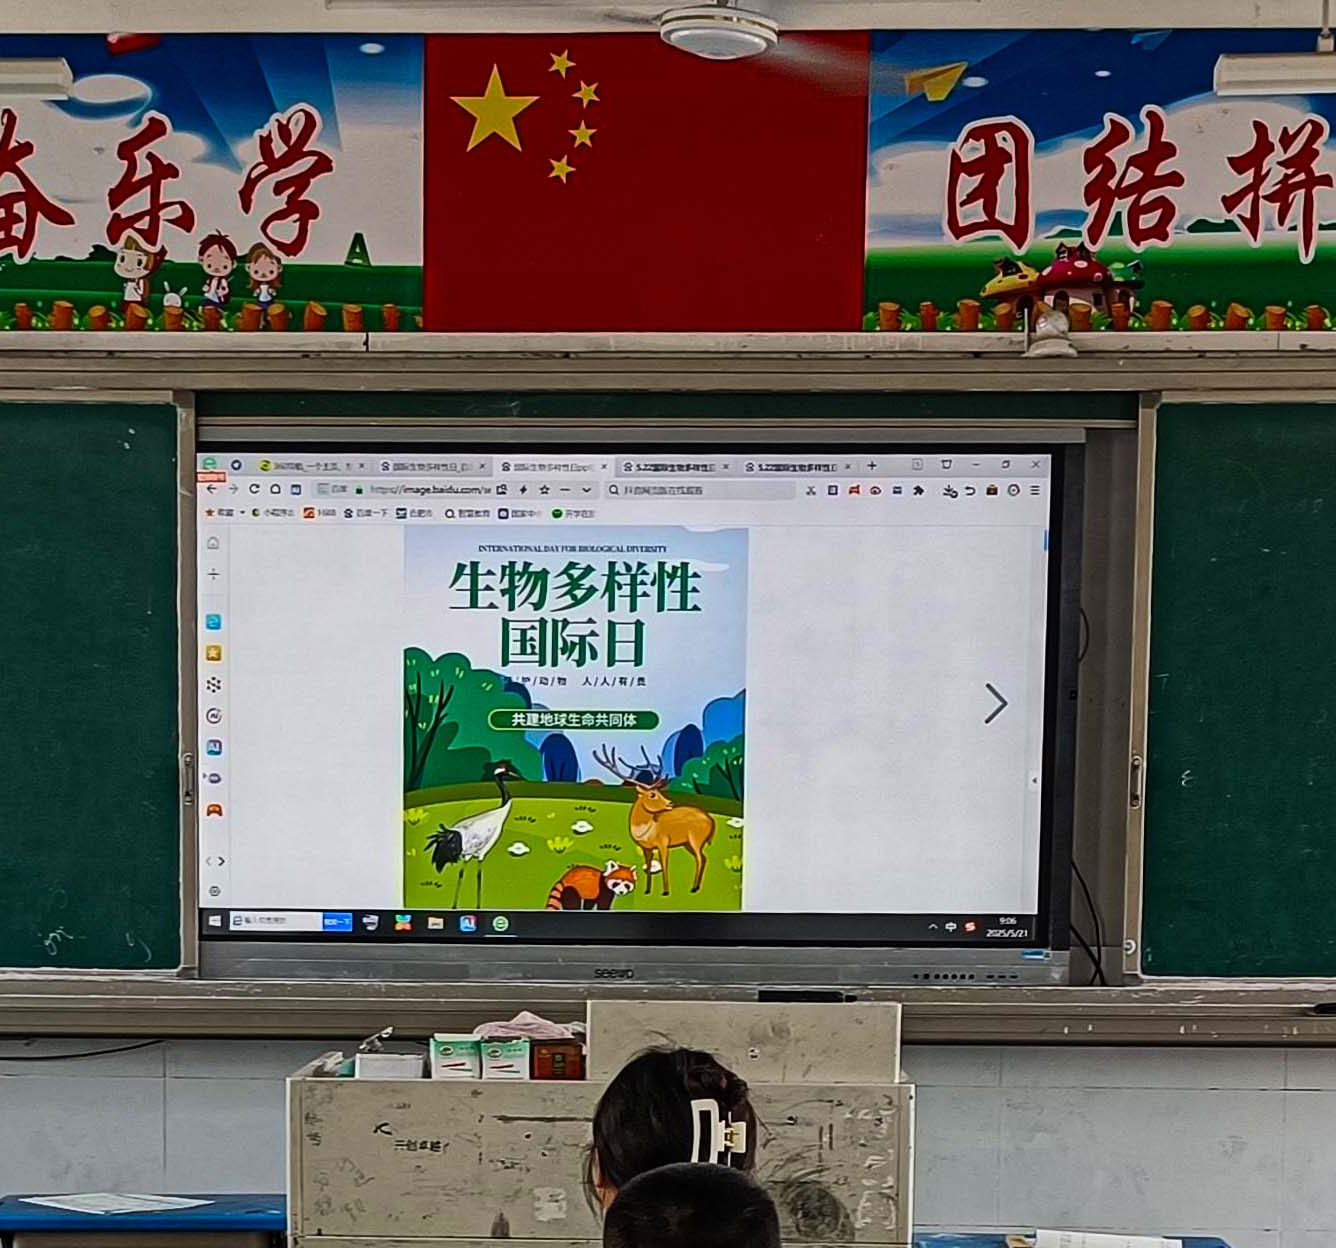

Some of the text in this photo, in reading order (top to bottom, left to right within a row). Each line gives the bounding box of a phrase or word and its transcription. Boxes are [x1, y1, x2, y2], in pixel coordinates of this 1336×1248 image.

[448, 560, 703, 614] 生物多样性
[500, 616, 646, 669] 国际日
[511, 712, 638, 728] 共建地球生命共同体
